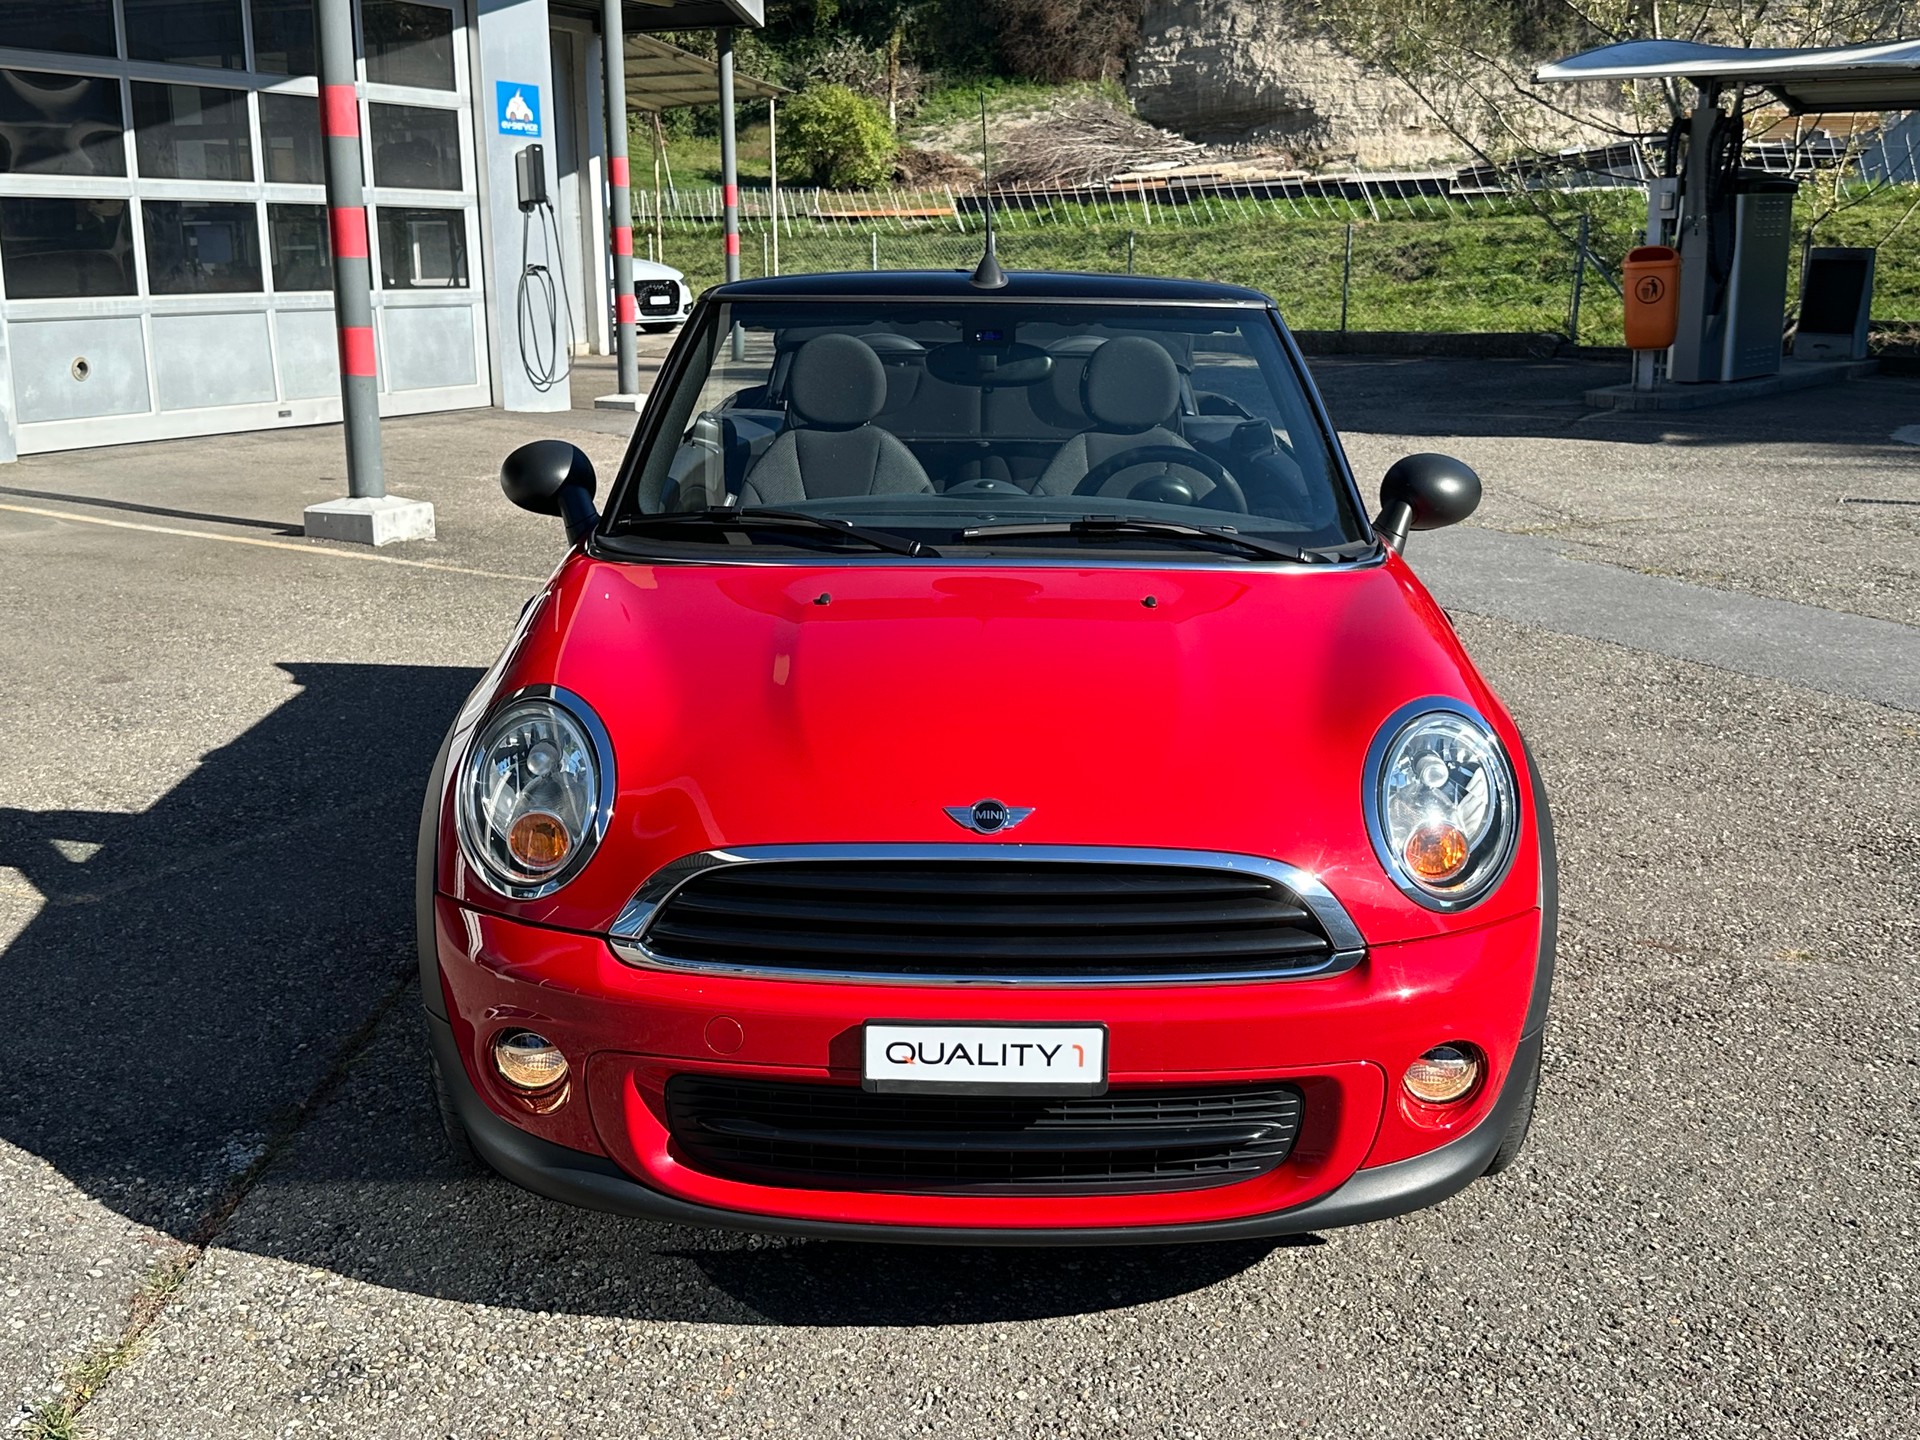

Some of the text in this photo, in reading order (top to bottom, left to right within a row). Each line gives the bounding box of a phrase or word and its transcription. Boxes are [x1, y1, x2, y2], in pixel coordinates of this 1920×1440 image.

[975, 810, 1003, 820] MINI
[885, 1041, 1084, 1067] QUALITY 1
